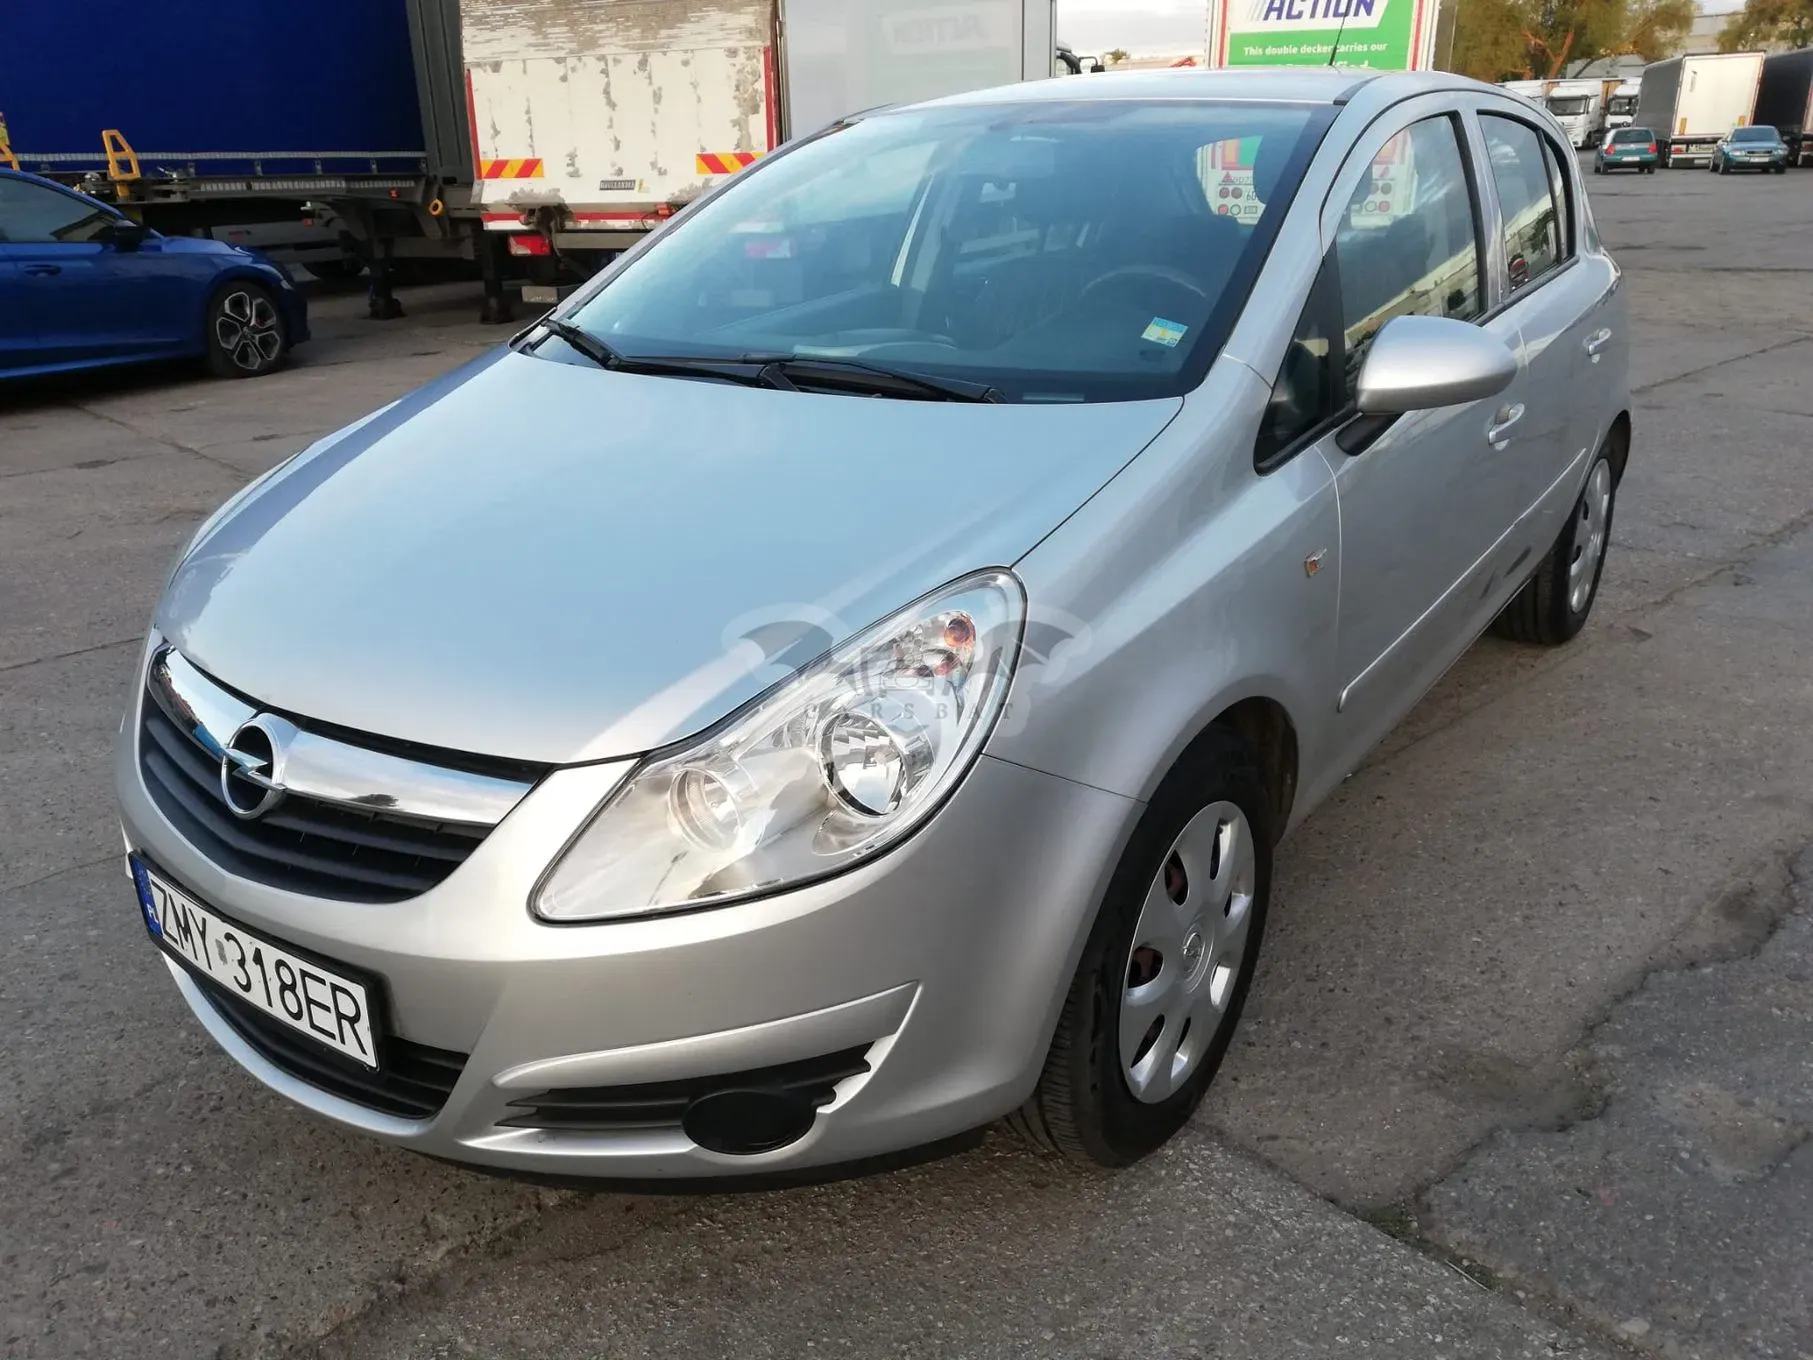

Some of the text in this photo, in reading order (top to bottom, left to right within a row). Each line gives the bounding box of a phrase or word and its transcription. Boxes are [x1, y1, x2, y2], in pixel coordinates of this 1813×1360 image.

[1263, 0, 1375, 20] ACTION
[1244, 42, 1388, 56] This double decker carries our
[151, 880, 367, 1055] ZMY 318ER
